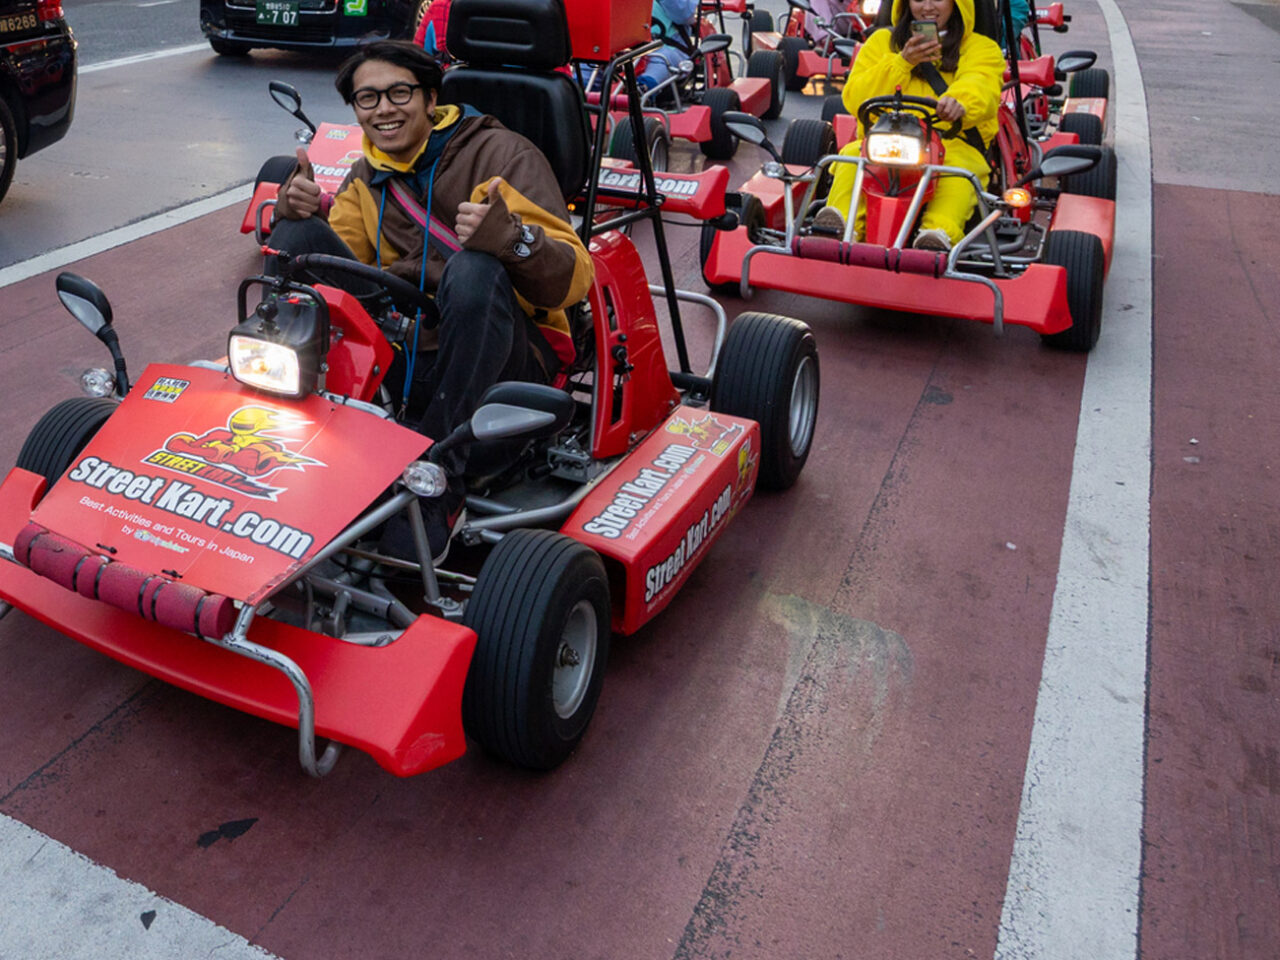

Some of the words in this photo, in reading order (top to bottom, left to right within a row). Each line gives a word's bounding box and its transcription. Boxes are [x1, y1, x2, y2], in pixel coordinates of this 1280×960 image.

[68, 455, 166, 504] Street
[148, 451, 207, 474] STREET
[79, 495, 106, 512] Best
[105, 505, 153, 528] Activities
[152, 521, 176, 536] and
[175, 527, 208, 548] Tours
[206, 539, 219, 552] in
[219, 543, 256, 565] Japan
[583, 490, 652, 539] Street
[645, 538, 687, 603] Street
